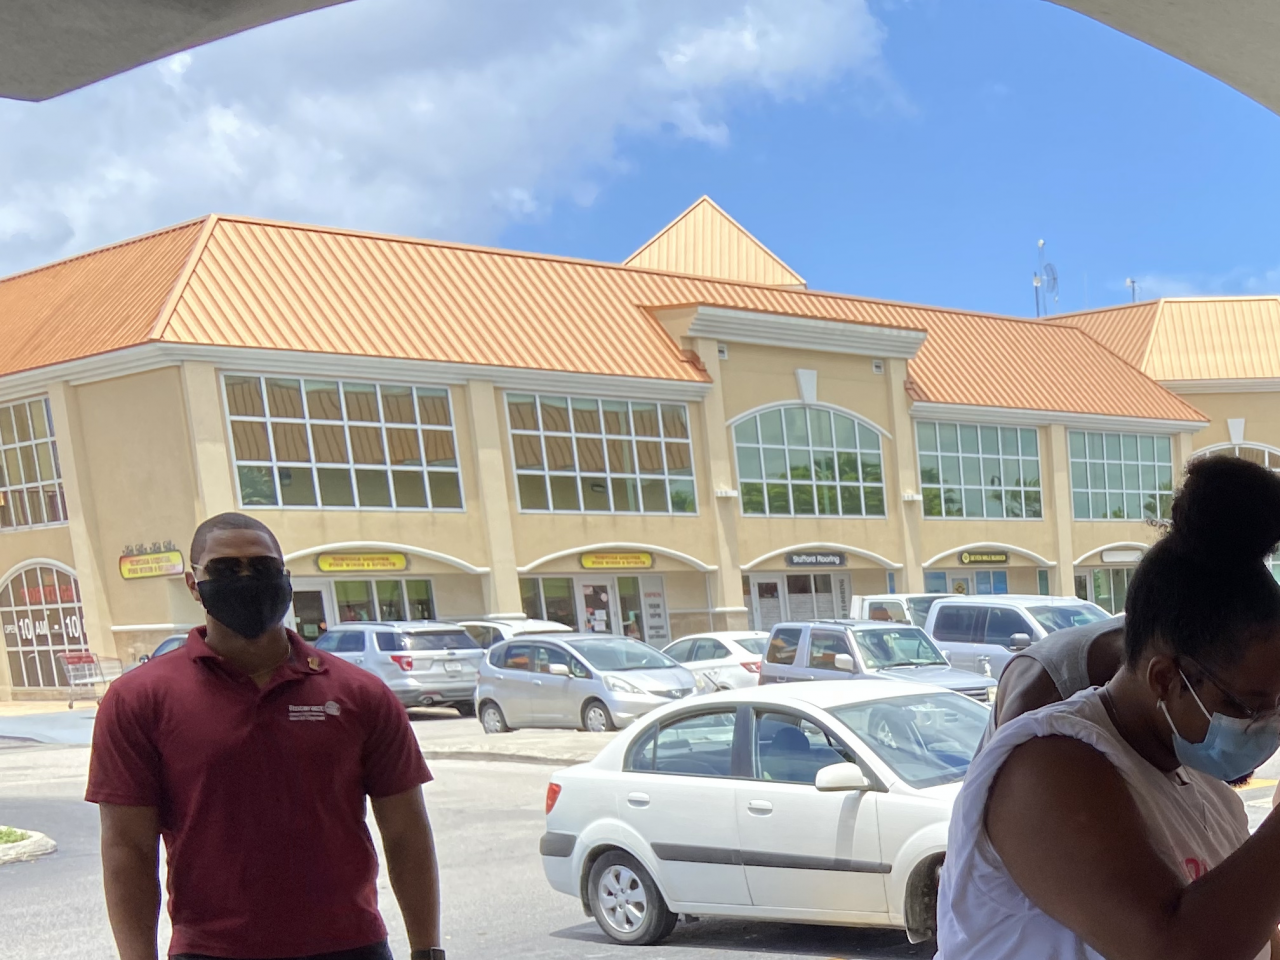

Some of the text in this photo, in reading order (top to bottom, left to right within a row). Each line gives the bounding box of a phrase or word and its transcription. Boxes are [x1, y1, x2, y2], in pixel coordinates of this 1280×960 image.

[817, 554, 840, 564] Flooring
[19, 618, 32, 640] 10
[35, 620, 48, 635] AM
[65, 616, 80, 638] 10
